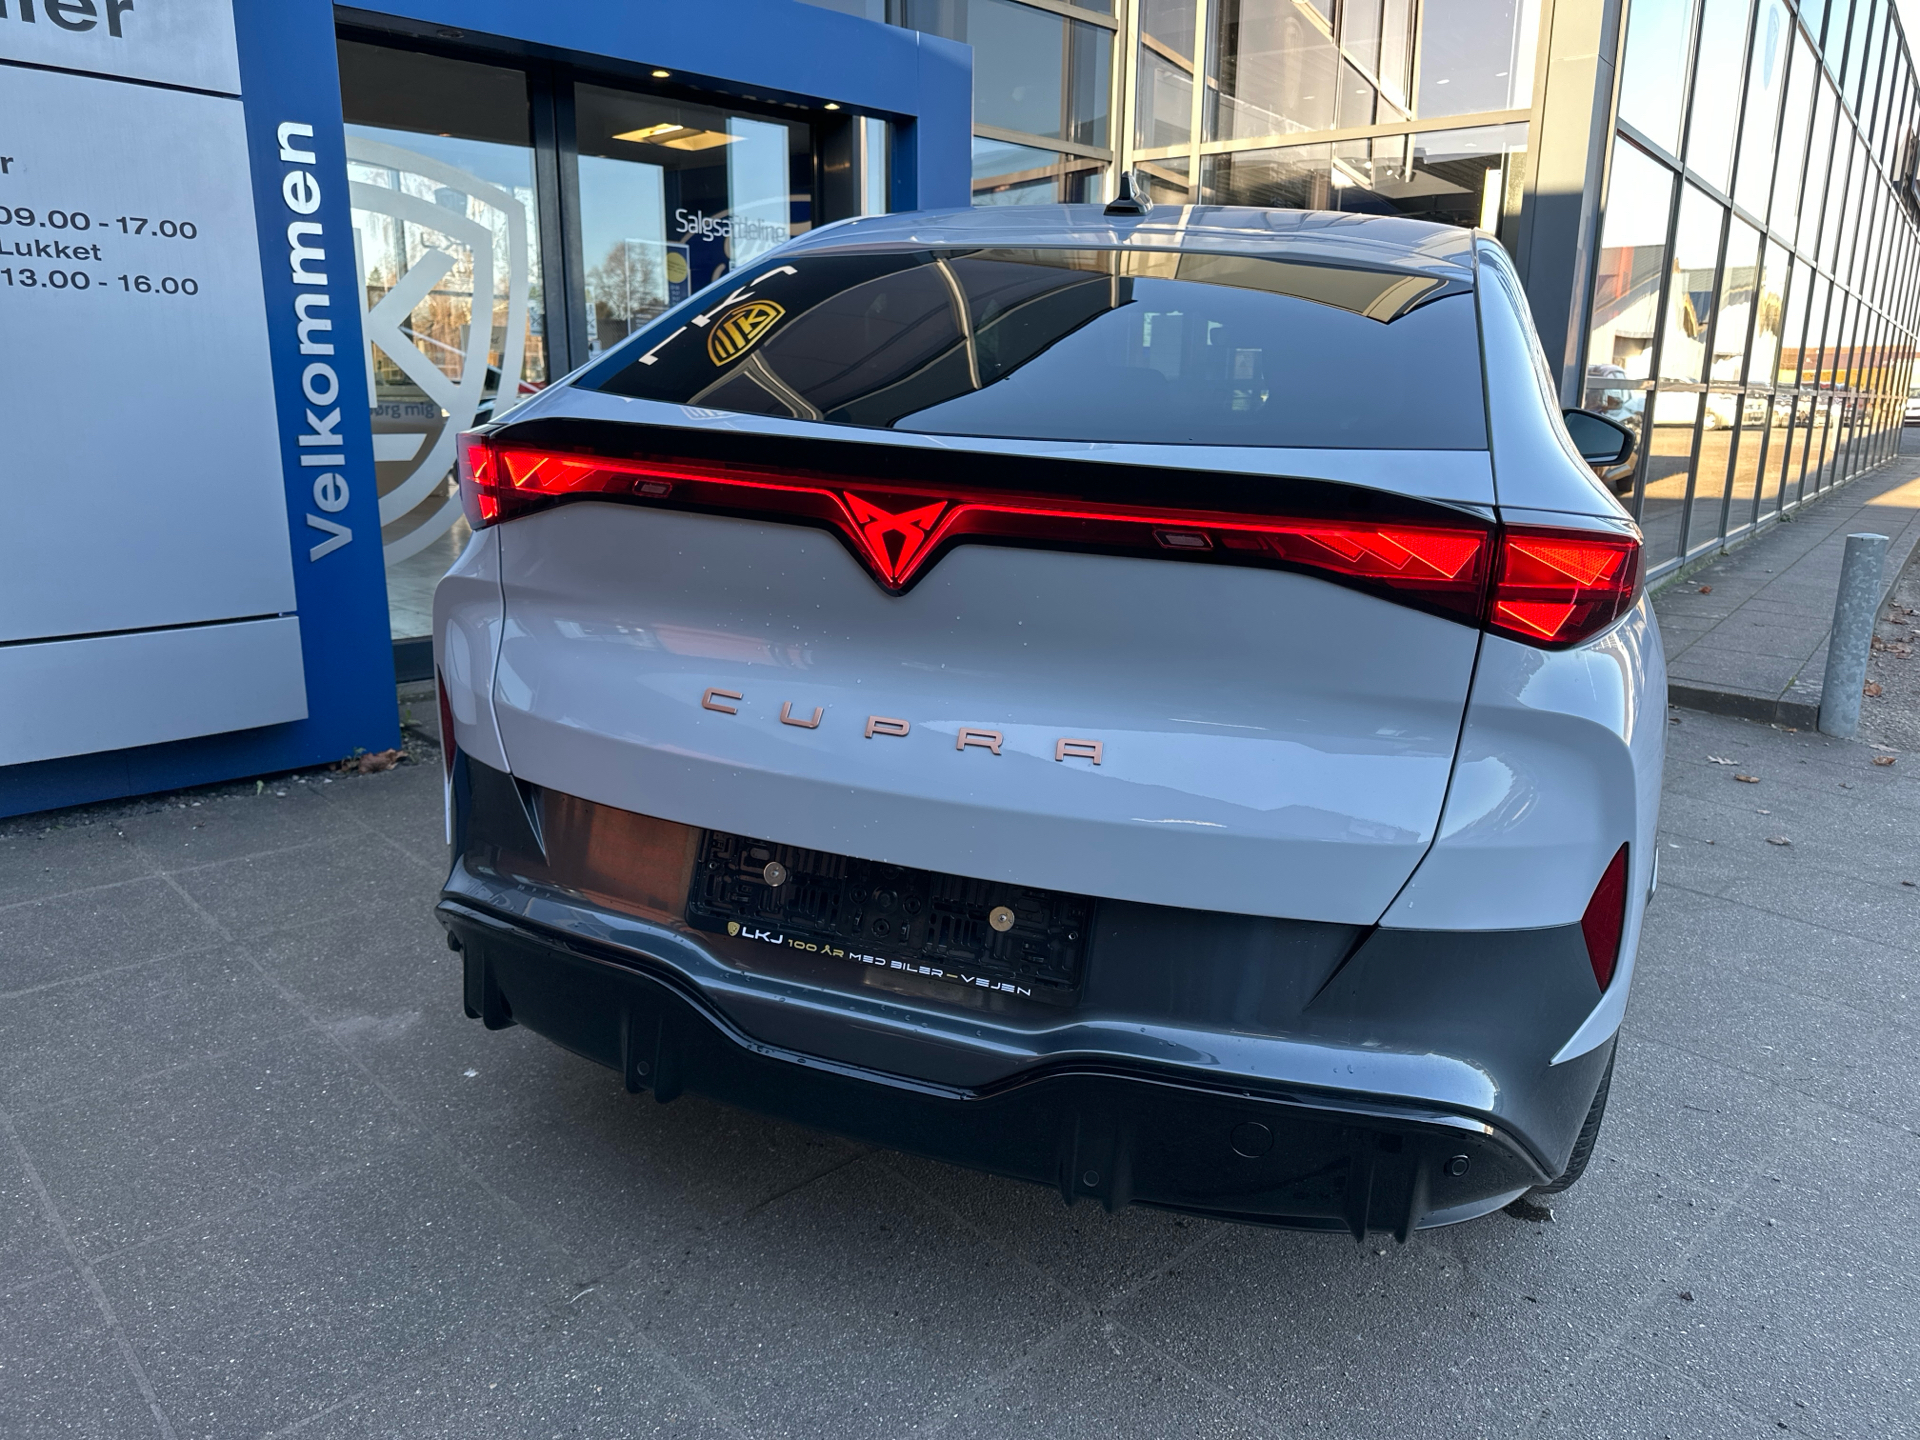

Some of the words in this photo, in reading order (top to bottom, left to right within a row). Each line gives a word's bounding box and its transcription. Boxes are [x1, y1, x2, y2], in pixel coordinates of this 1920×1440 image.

[116, 216, 197, 239] 17.00
[1, 268, 90, 290] 13.00
[118, 274, 198, 296] 16.00
[277, 121, 353, 562] Velkommen
[404, 401, 435, 419] mig
[702, 687, 1103, 765] CUPRA
[742, 926, 783, 944] LKJ
[788, 939, 817, 952] 100
[821, 944, 844, 958] ÅR
[850, 952, 886, 966] MED
[890, 960, 943, 977] BILER
[961, 974, 1031, 996] VEJEN
